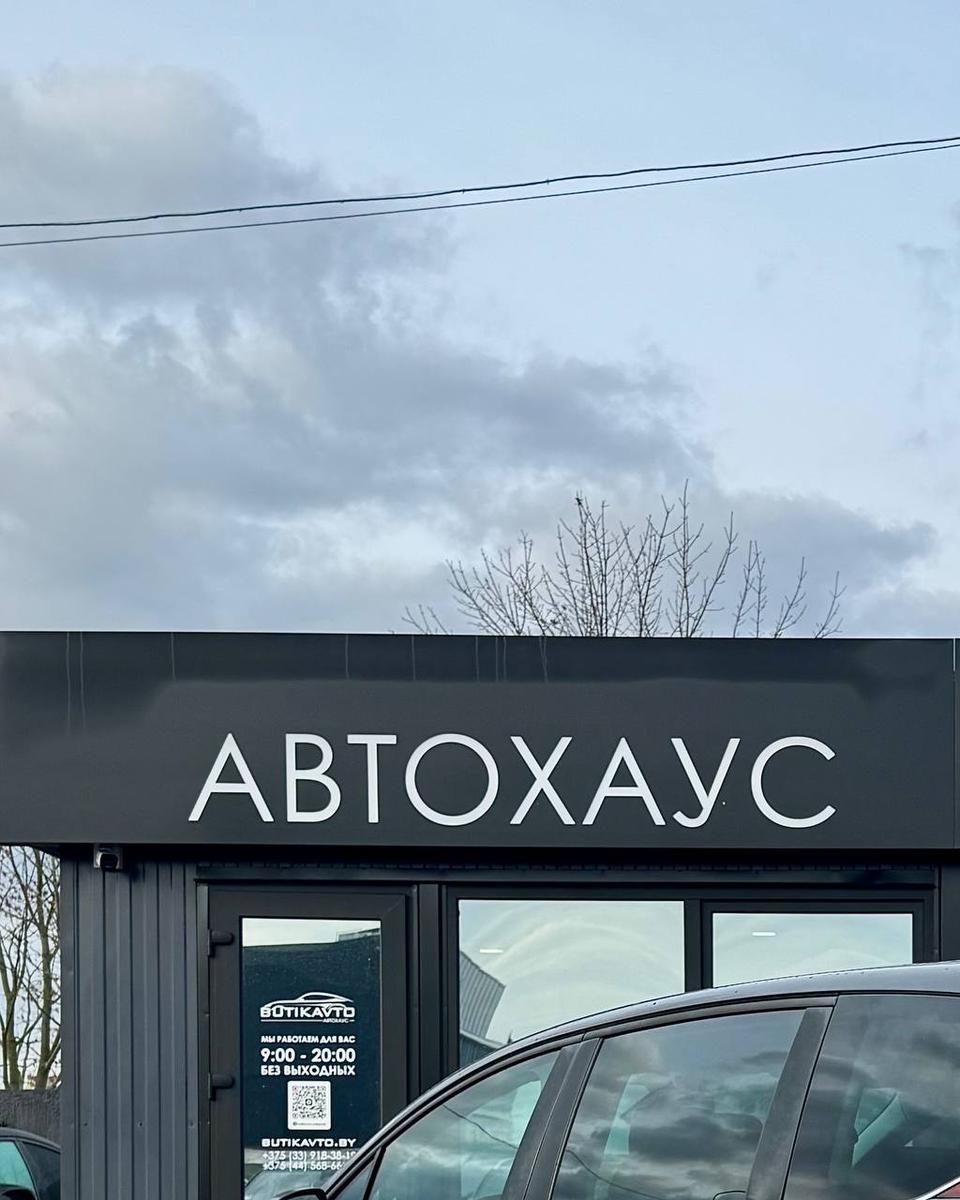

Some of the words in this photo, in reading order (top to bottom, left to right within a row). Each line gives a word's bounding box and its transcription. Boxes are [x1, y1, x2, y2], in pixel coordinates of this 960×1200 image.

[188, 733, 837, 828] АВТОХАУС
[260, 1006, 355, 1018] BUTIKAVTO
[319, 1036, 337, 1044] ДЛЯ
[260, 1048, 295, 1063] 9:00
[311, 1048, 356, 1063] 20:00
[260, 1065, 281, 1076] БЕЗ
[283, 1065, 356, 1076] ВЫХОДНЫХ
[261, 1138, 356, 1147] BUTIKAVTO.BY
[262, 1151, 286, 1160] +375
[288, 1150, 307, 1161] (33)
[288, 1161, 307, 1172] (44)
